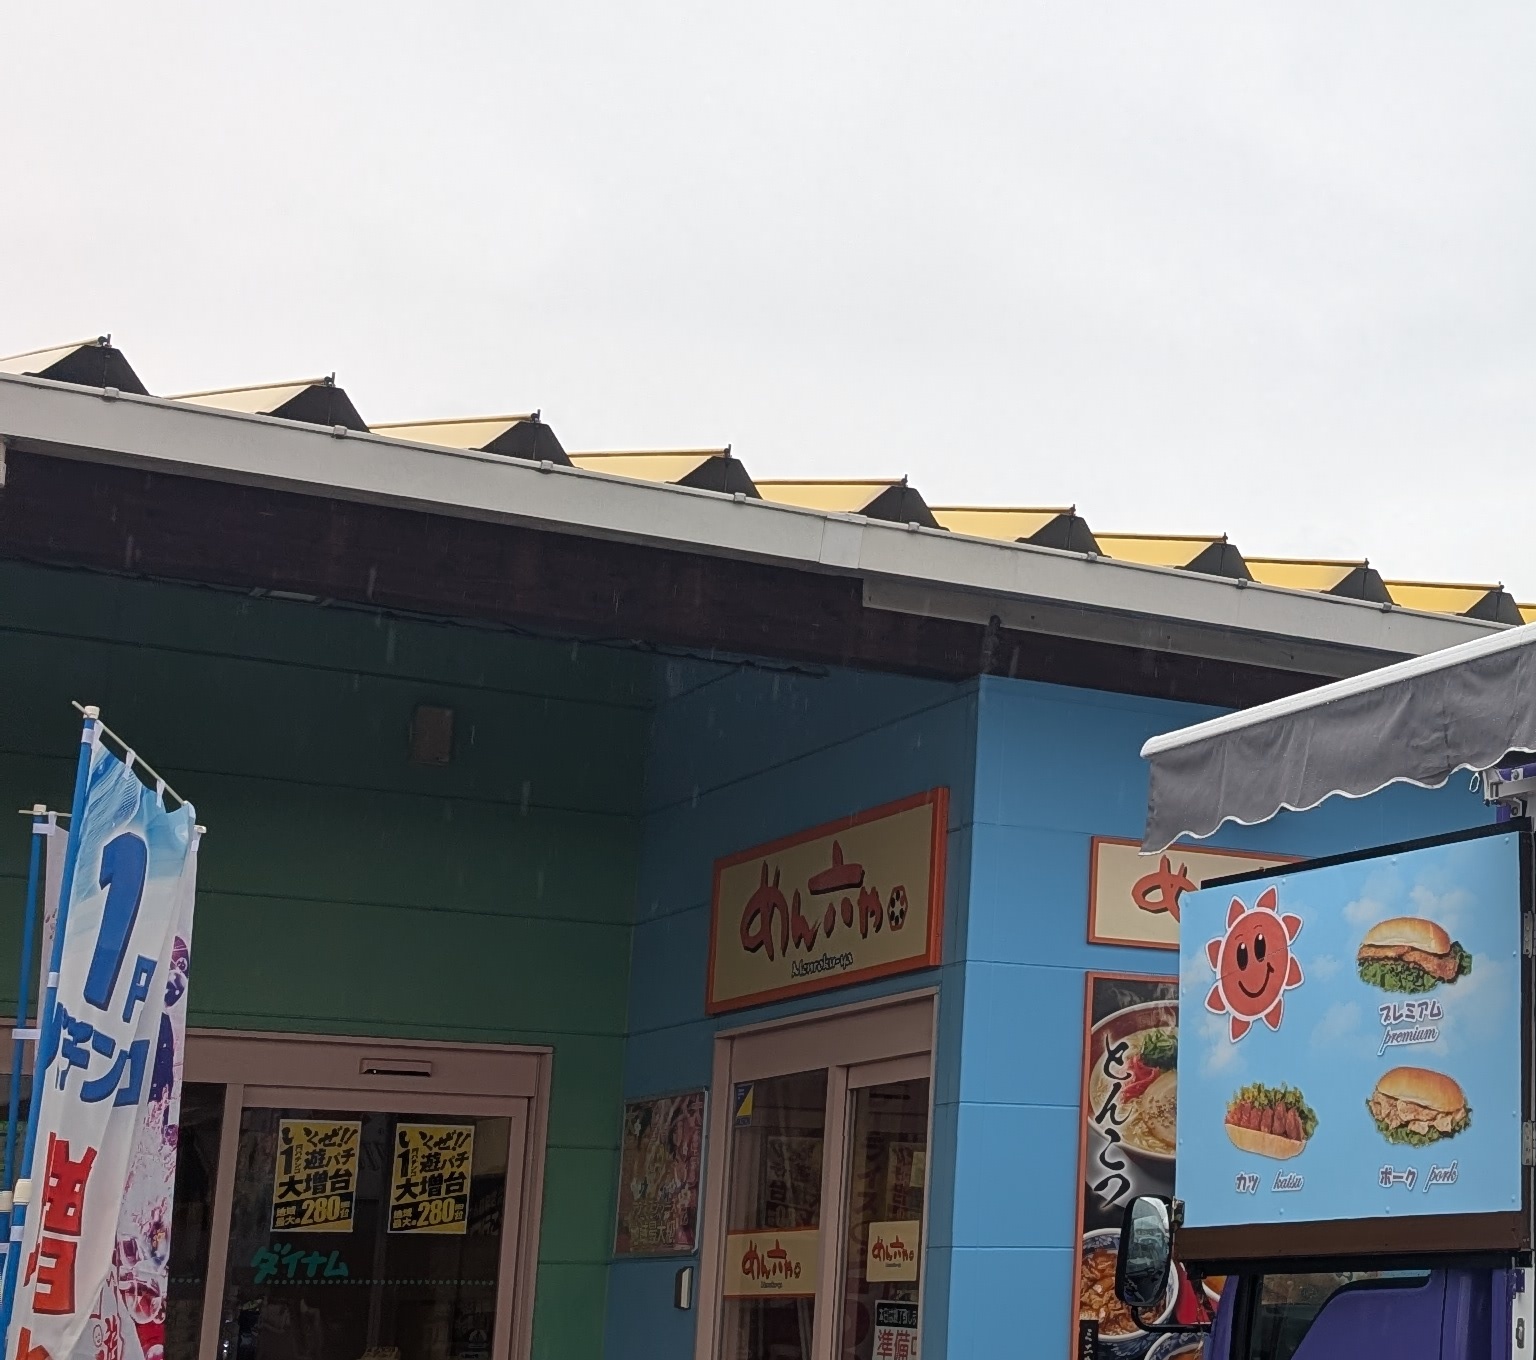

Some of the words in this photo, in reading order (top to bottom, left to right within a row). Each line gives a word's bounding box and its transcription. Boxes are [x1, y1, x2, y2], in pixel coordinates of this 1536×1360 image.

[1379, 999, 1443, 1024] プレミアム
[1377, 1026, 1439, 1056] premium
[1094, 1034, 1133, 1208] とんこつ
[1236, 1172, 1260, 1193] カツ
[1272, 1170, 1304, 1192] katsu
[1379, 1165, 1417, 1190] ポーク
[1423, 1160, 1458, 1192] pork
[251, 1242, 349, 1284] ダイナム
